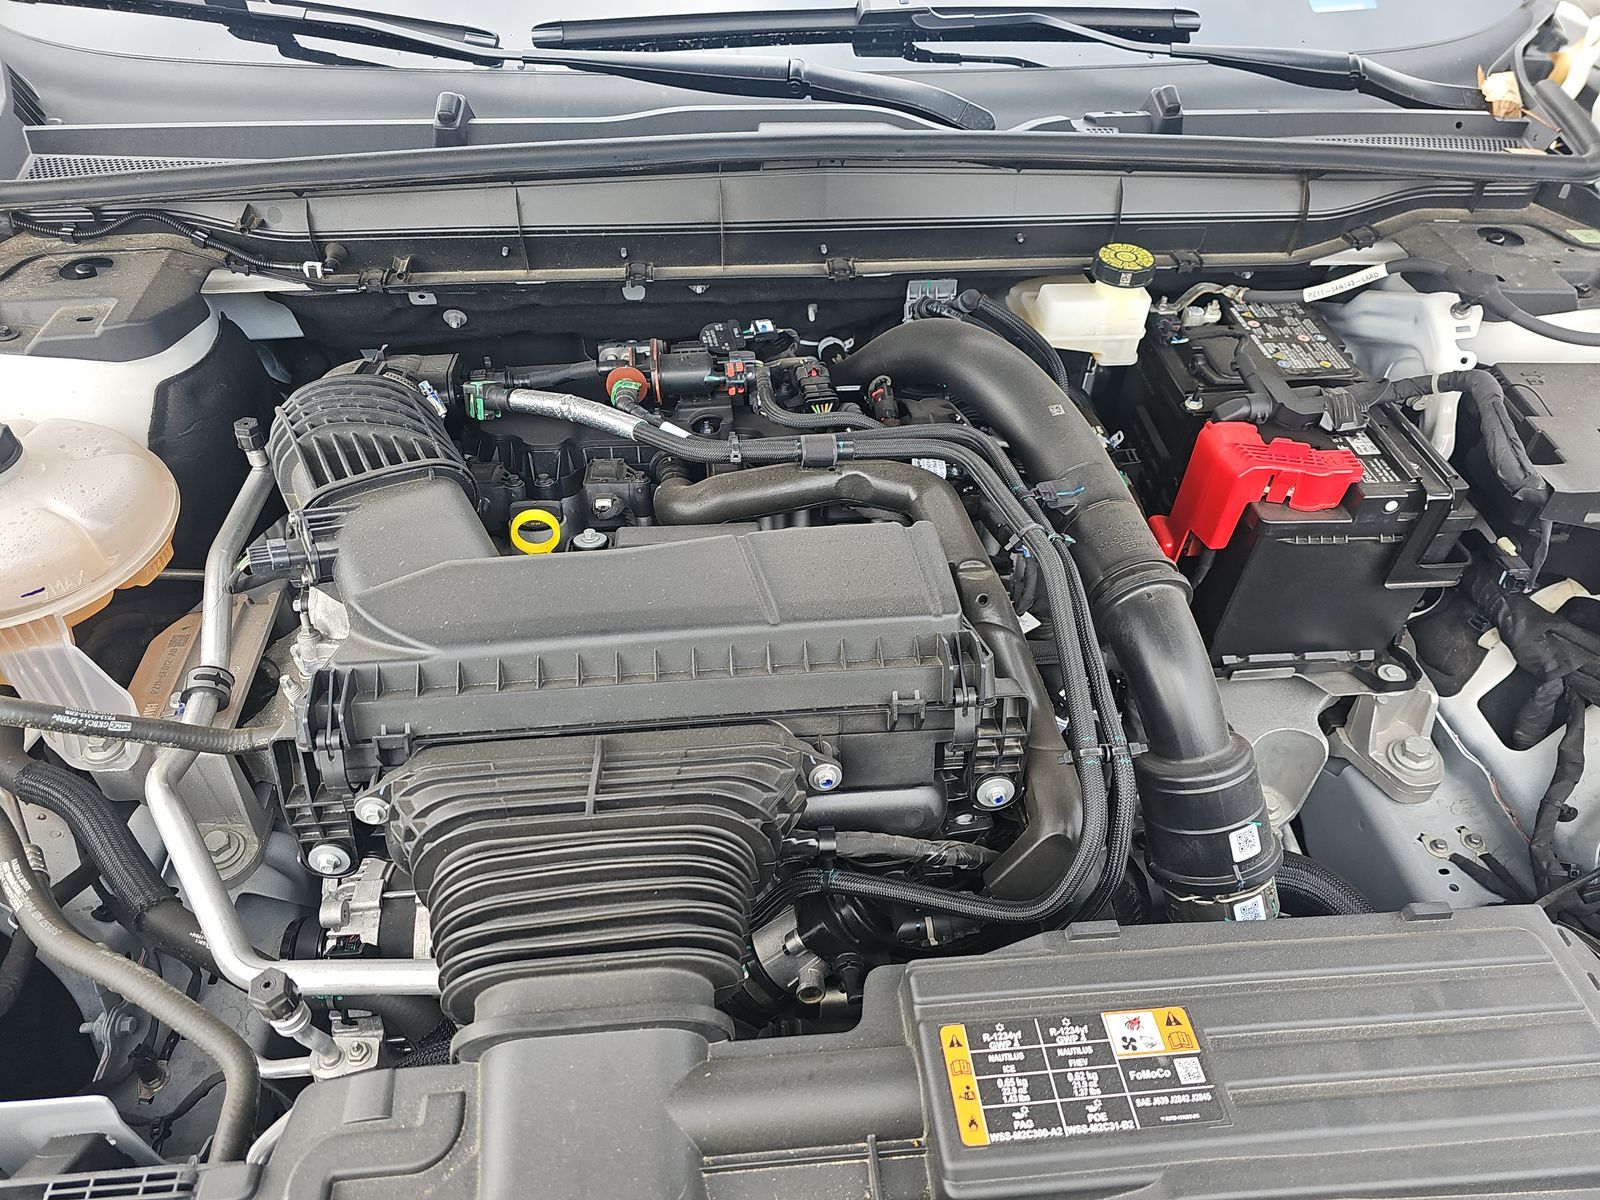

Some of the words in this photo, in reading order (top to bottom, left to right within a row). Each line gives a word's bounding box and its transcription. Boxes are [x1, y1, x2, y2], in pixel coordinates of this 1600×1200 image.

[1057, 1046, 1094, 1056] NAUTILUS
[988, 1052, 1025, 1063] NAUTILUS
[1002, 1064, 1017, 1073] ICE
[1086, 1071, 1099, 1083] kg
[1129, 1068, 1172, 1081] FoMoCo
[1016, 1077, 1028, 1089] kg
[1089, 1087, 1101, 1095] lbs
[1018, 1094, 1031, 1102] lbs
[1135, 1097, 1152, 1108] SAE
[1087, 1112, 1108, 1123] POE
[1013, 1119, 1035, 1130] PAG
